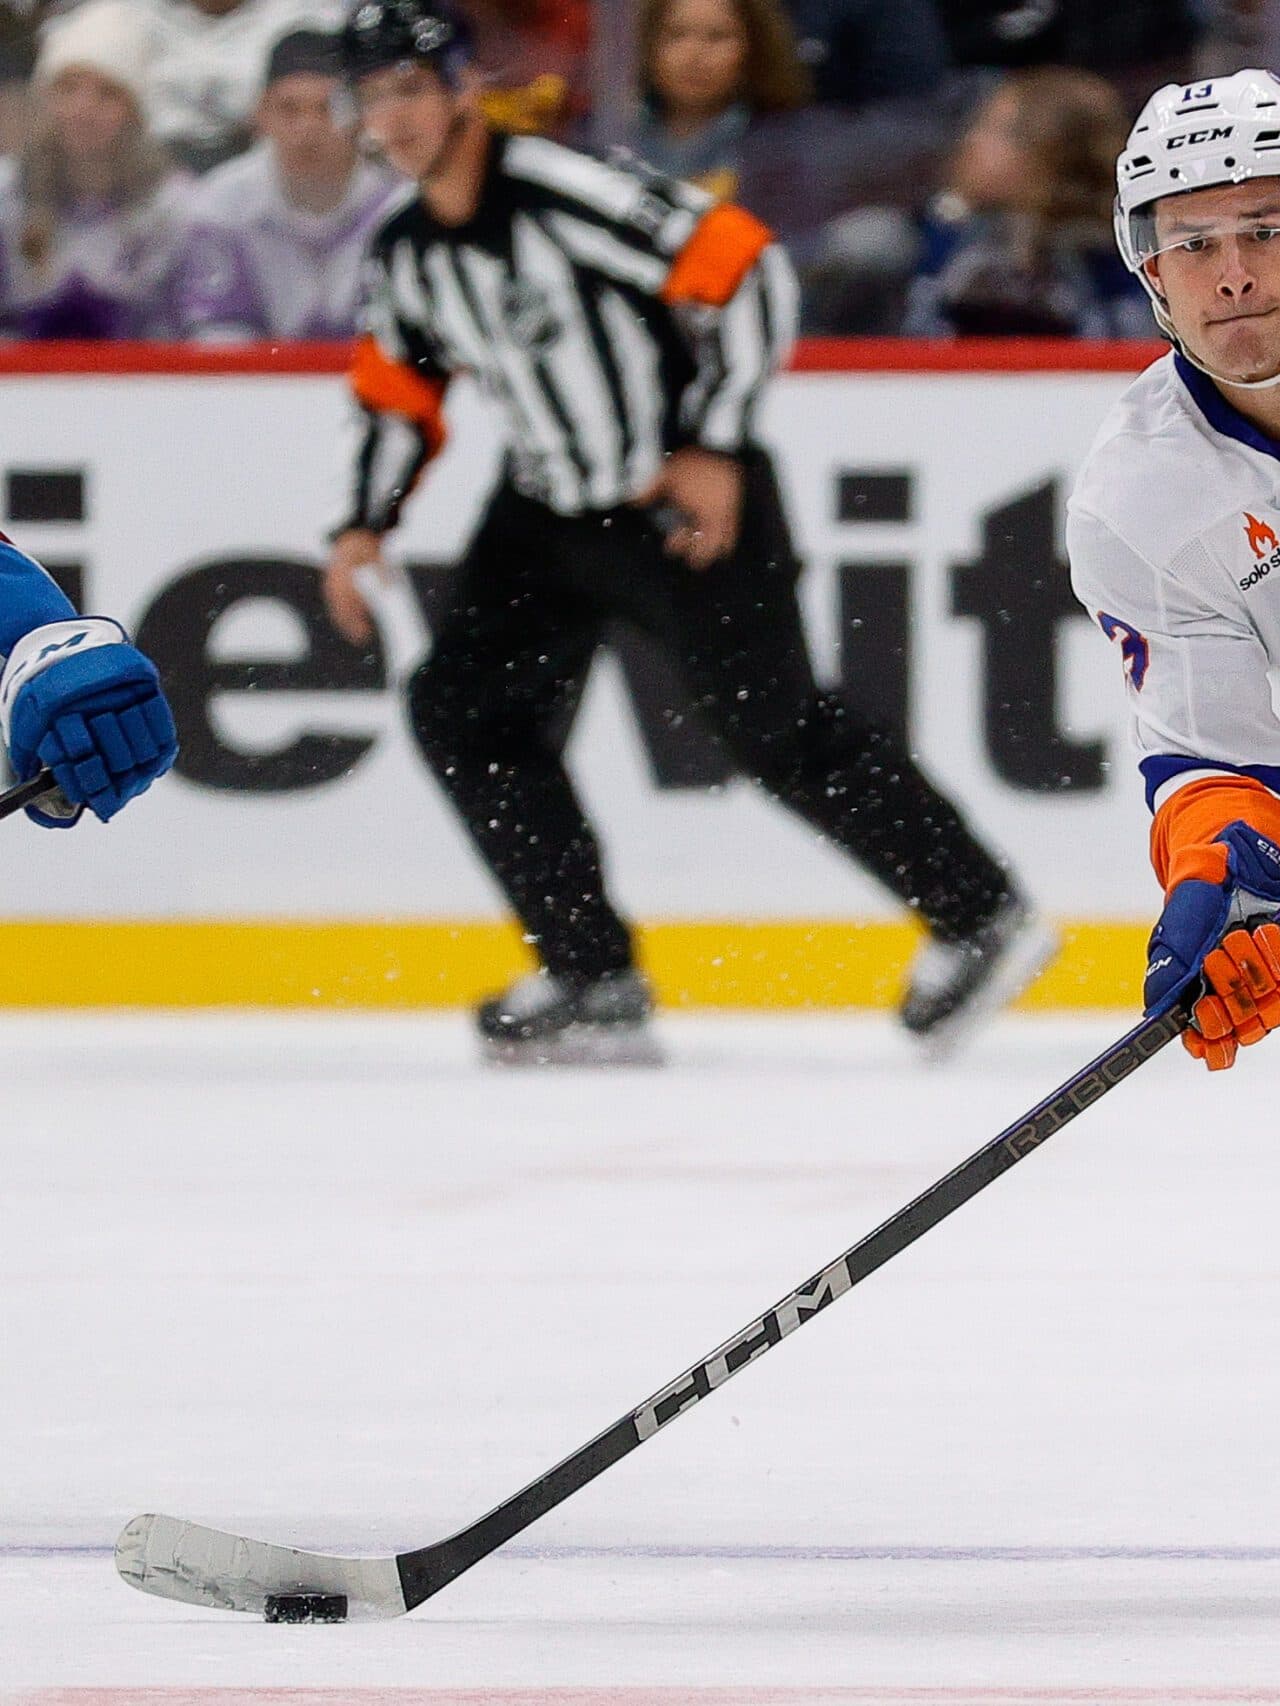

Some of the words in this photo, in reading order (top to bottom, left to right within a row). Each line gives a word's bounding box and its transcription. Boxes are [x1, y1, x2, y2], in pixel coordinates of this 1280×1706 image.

[1181, 84, 1213, 102] 13
[1166, 126, 1235, 150] CCM
[1239, 564, 1270, 591] solo
[633, 1252, 853, 1441] CCM
